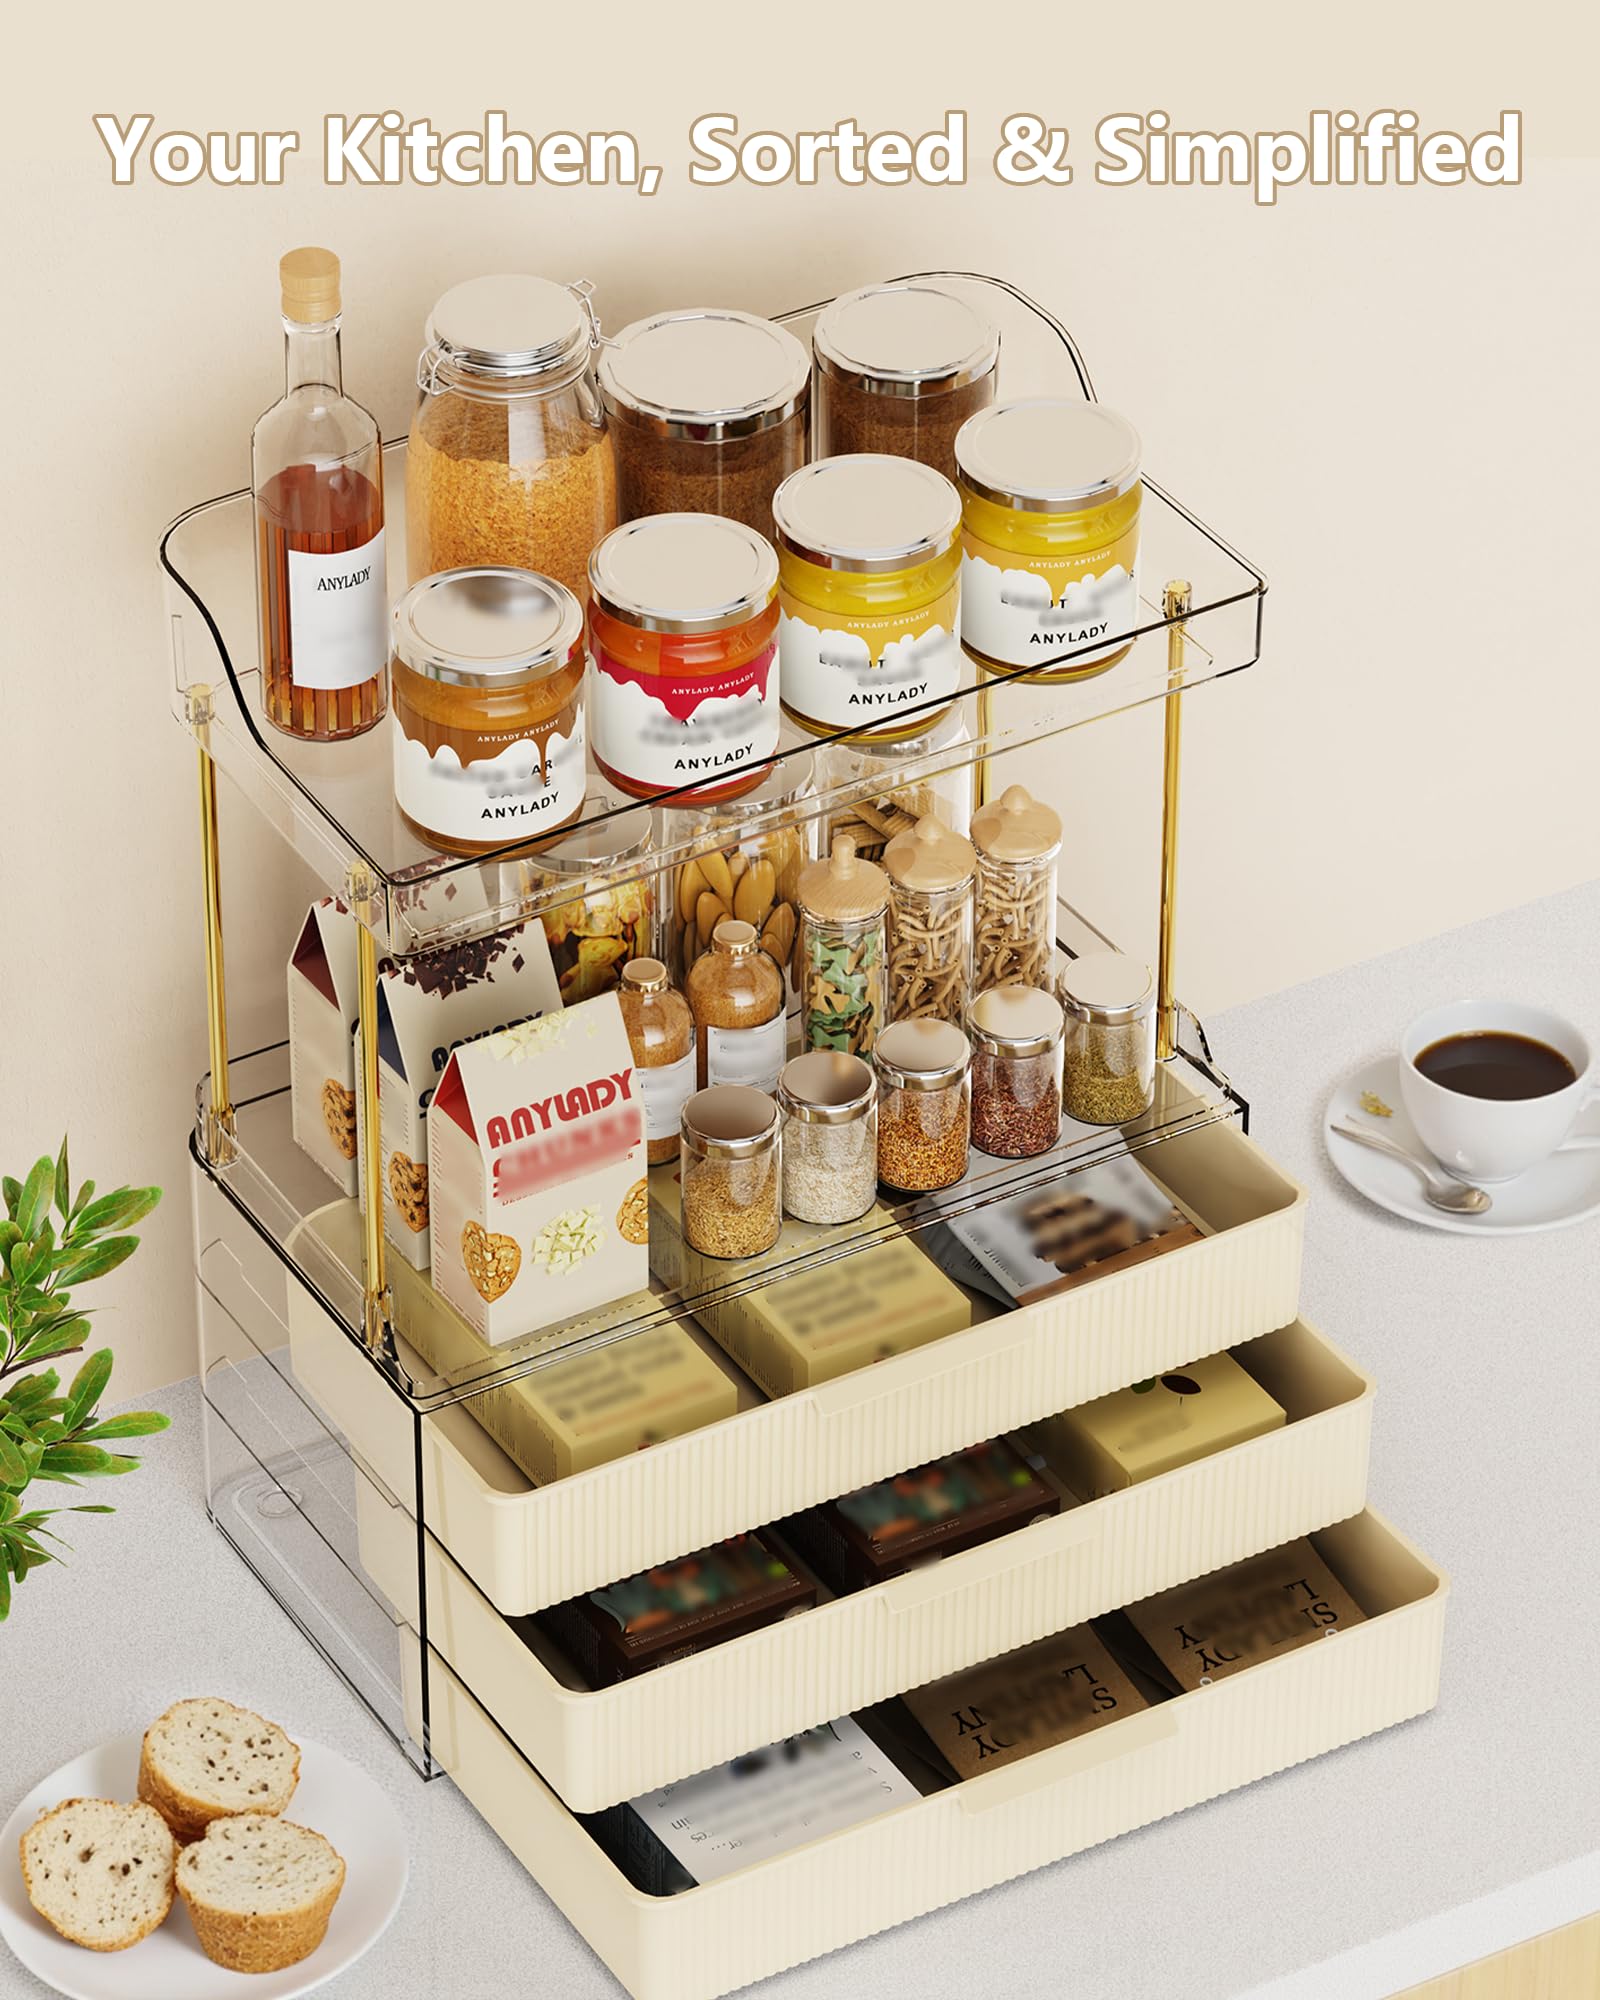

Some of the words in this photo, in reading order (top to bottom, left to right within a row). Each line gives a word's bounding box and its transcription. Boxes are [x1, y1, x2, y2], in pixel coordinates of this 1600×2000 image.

[1029, 560, 1072, 569] ANYLADY
[1074, 551, 1112, 567] ANYLADY
[317, 565, 372, 592] ANYLADY
[847, 621, 890, 629] ANYLADY
[892, 611, 931, 627] ANYLADY
[1029, 622, 1109, 645] ANYLADY
[671, 686, 716, 695] ANYLADY
[718, 671, 755, 691] ANYLADY
[848, 682, 929, 705] ANYLADY
[477, 732, 521, 743] ANYLADY
[523, 718, 561, 738] ANYLADY
[674, 742, 754, 770] ANYLADY
[480, 791, 560, 820] ANYLADY
[486, 1067, 633, 1150] ANYLADY
